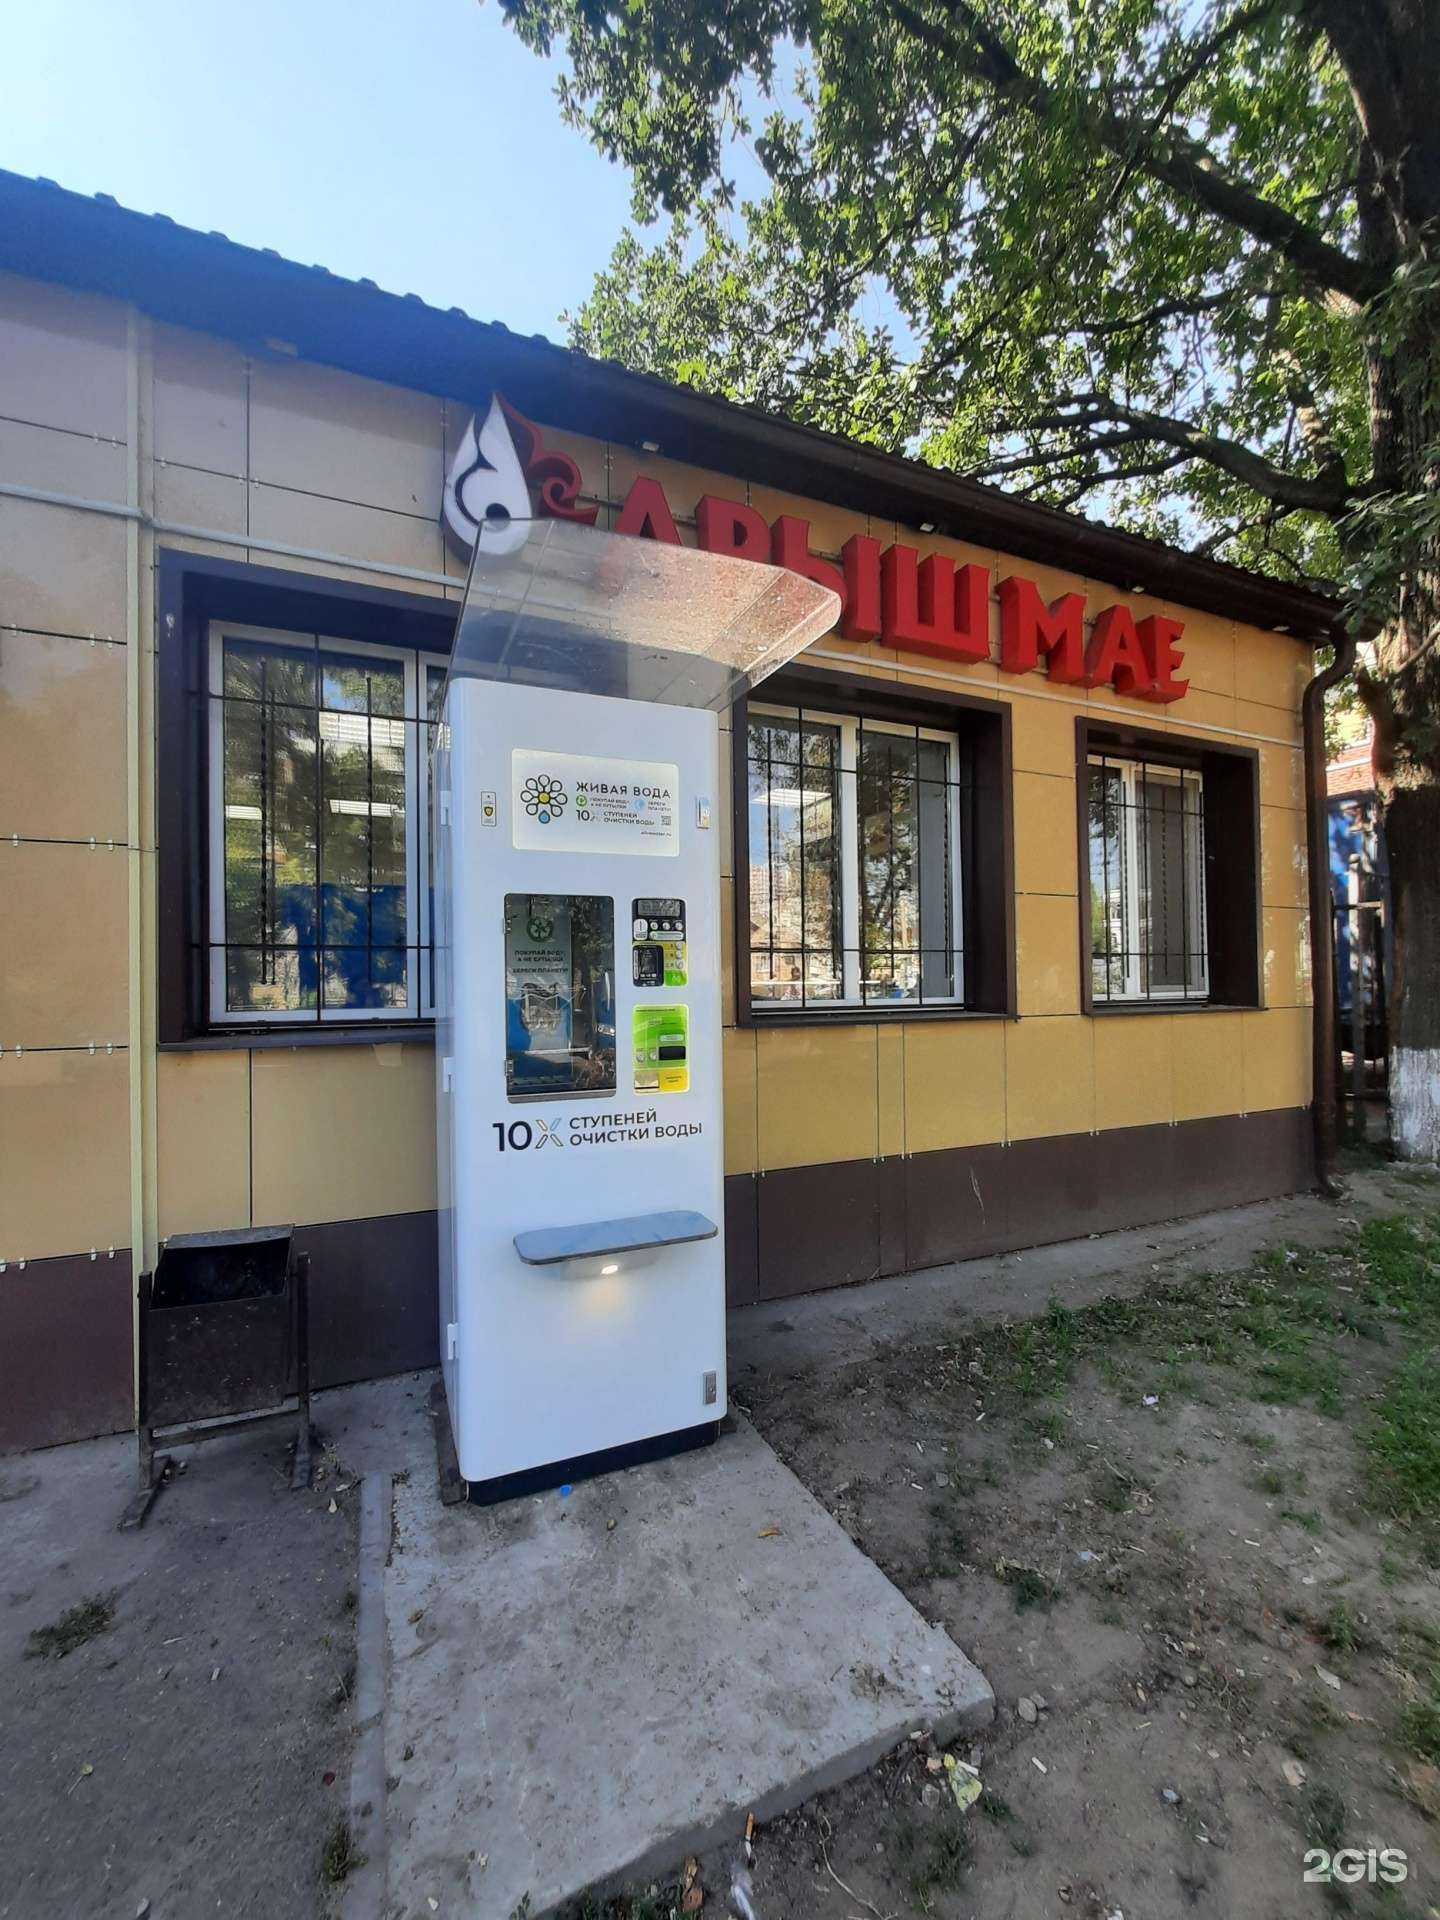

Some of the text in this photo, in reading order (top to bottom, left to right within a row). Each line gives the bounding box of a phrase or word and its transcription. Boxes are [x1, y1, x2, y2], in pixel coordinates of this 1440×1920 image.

[576, 781, 671, 799] ЖИВАЯ ВОДА
[569, 1107, 657, 1130] СТУПЕНЕЙ
[569, 1122, 702, 1146] ОЧИСТКИ ВОДЫ
